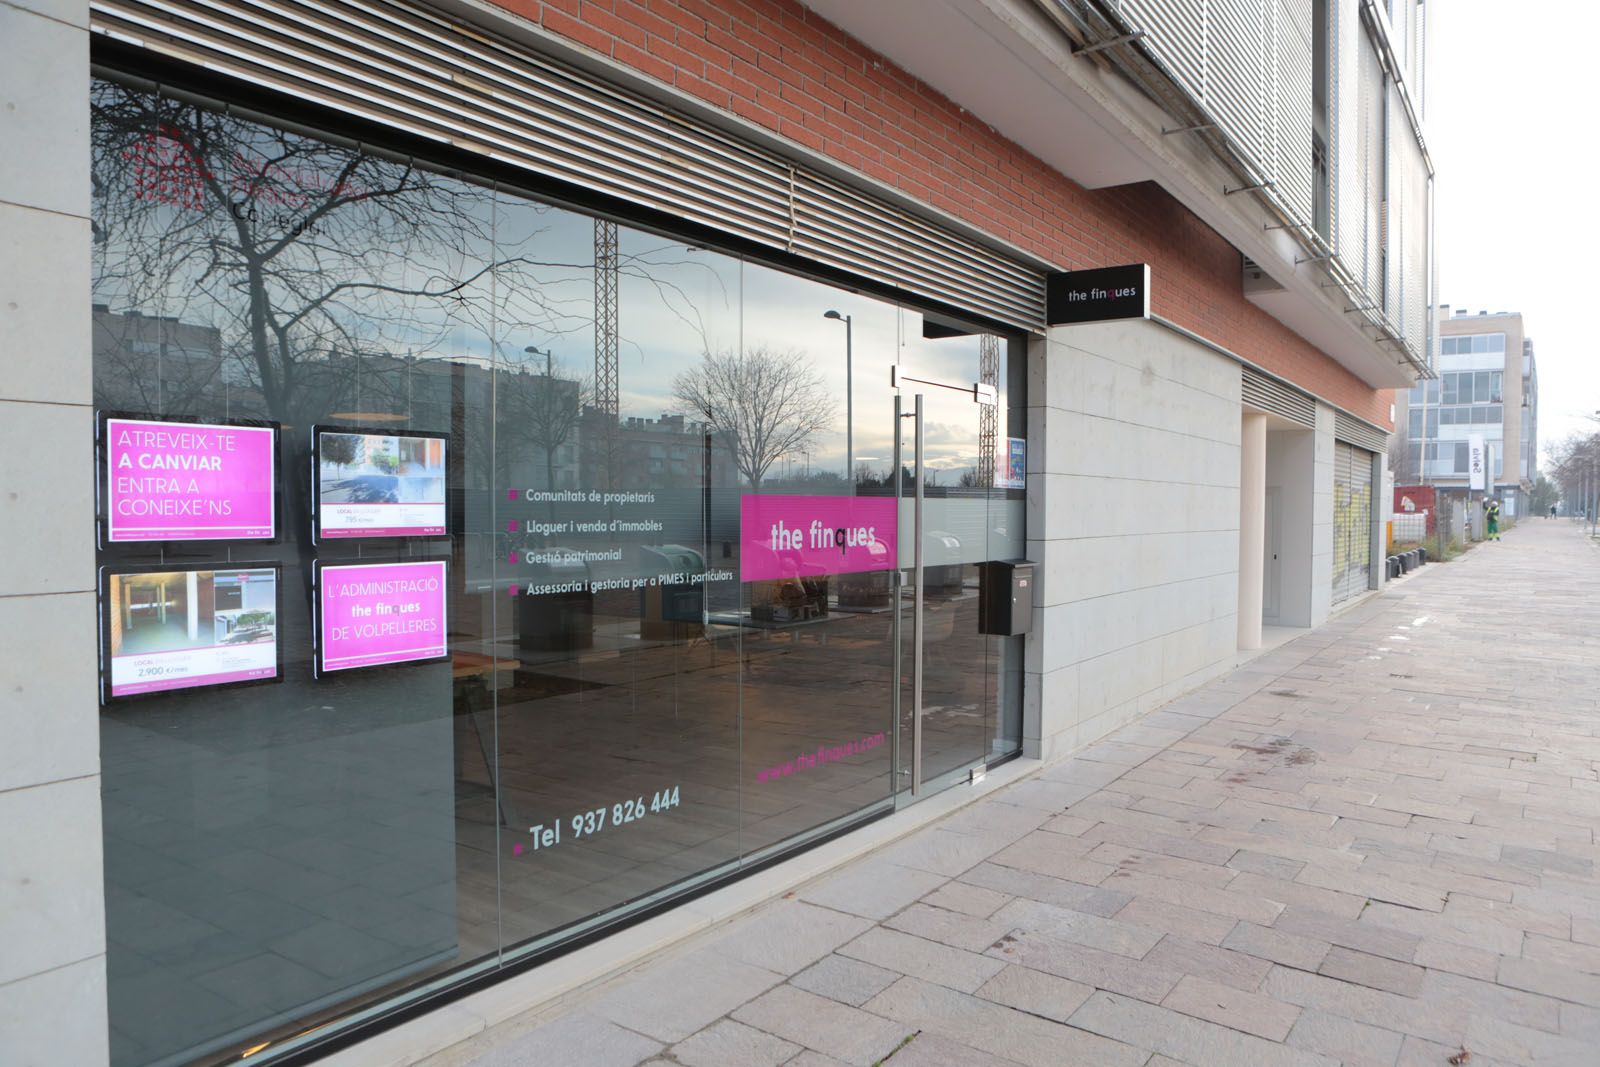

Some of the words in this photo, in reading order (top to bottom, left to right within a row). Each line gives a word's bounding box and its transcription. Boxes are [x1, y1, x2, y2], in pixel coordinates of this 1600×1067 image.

[1068, 290, 1087, 302] the
[1091, 287, 1136, 301] finques
[118, 430, 236, 451] ATREVEIX-TE
[118, 453, 132, 469] A
[138, 454, 222, 471] CANVIAR
[118, 477, 181, 494] ENTRA
[187, 479, 199, 494] A
[526, 489, 586, 502] Comunitats
[589, 491, 601, 503] de
[604, 492, 655, 504] propietaris
[527, 521, 568, 535] Lloguer
[570, 521, 573, 532] i
[576, 521, 607, 532] venda
[771, 520, 803, 551] the
[809, 520, 875, 555] finques
[526, 551, 562, 564] Gestió
[564, 549, 621, 564] patrimonial
[328, 576, 439, 599] L'ADMINISTRACIÓ
[527, 581, 581, 596] Assessoria
[585, 581, 588, 592] i
[591, 578, 630, 593] gestoria
[632, 577, 647, 590] per
[658, 573, 684, 585] PIMES
[687, 573, 689, 583] i
[691, 569, 732, 583] particulars
[352, 605, 372, 617] the
[376, 603, 420, 617] finques
[332, 627, 349, 641] DE
[354, 617, 437, 638] VOLPELLERES
[138, 667, 163, 676] 2.900
[756, 732, 885, 784] www.thefinques.com
[530, 819, 560, 850] Tel
[572, 808, 606, 838] 937
[612, 798, 645, 826] 826
[651, 786, 680, 813] 444
